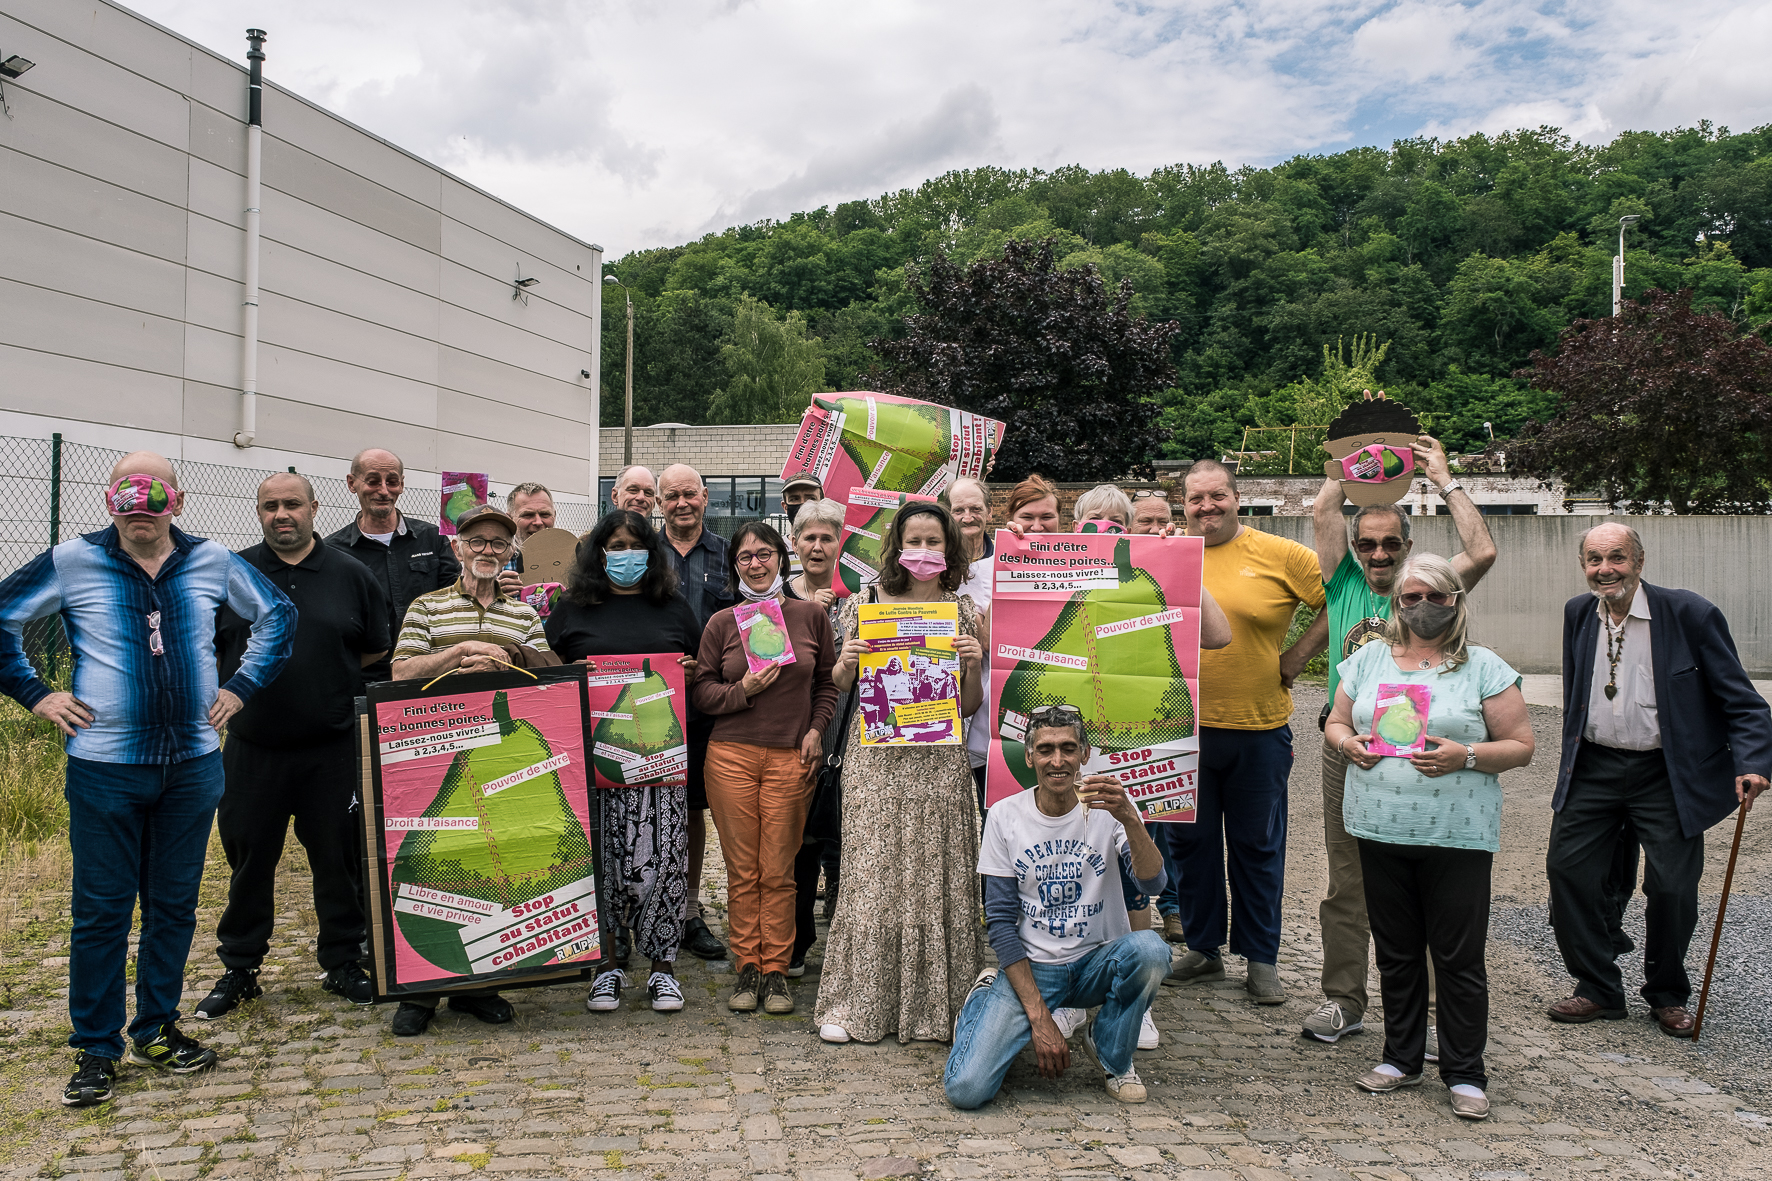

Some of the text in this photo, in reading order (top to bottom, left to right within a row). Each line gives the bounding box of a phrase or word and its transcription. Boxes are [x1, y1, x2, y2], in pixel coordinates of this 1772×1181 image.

[795, 445, 805, 460] Fini
[802, 422, 815, 444] d'être
[950, 434, 960, 461] Stop
[972, 424, 982, 478] ohabitant
[802, 439, 819, 468] bonnes
[813, 438, 829, 475] aissez-nous
[871, 452, 890, 482] l'aisance
[961, 461, 968, 476] au
[926, 468, 943, 488] amour
[1029, 542, 1087, 552] Fini d'être
[1000, 553, 1116, 568] des bonnes poires...
[1042, 582, 1082, 590] 2,3,4,5...
[1096, 610, 1182, 635] Pouvoir de vivre
[1000, 645, 1087, 667] Droit à l'aisance
[404, 702, 465, 717] Fini d'être
[399, 718, 445, 732] bonnes
[448, 714, 496, 728] poires...
[1014, 715, 1028, 727] Lib
[389, 732, 454, 749] Laissez-nous
[456, 727, 480, 737] vivre
[422, 743, 464, 756] 2,3,4,5...
[645, 753, 665, 762] Stop
[1109, 749, 1152, 765] Stop
[634, 764, 680, 781] cohabitant
[650, 757, 675, 769] statut
[1120, 760, 1175, 781] statut
[482, 754, 569, 794] Pouvoir de vivre
[1128, 774, 1193, 797] bitant !
[1147, 799, 1180, 815] RWLP
[386, 818, 478, 828] Droit à l'aisance
[1036, 862, 1082, 881] COLLEGE
[408, 886, 494, 912] Libre en amour
[1042, 882, 1076, 906] 199
[412, 903, 482, 925] et vie privée
[511, 894, 555, 918] Stop
[1040, 905, 1079, 918] HOCKEY
[500, 902, 580, 944] au statut
[492, 916, 591, 966] cohabitant
